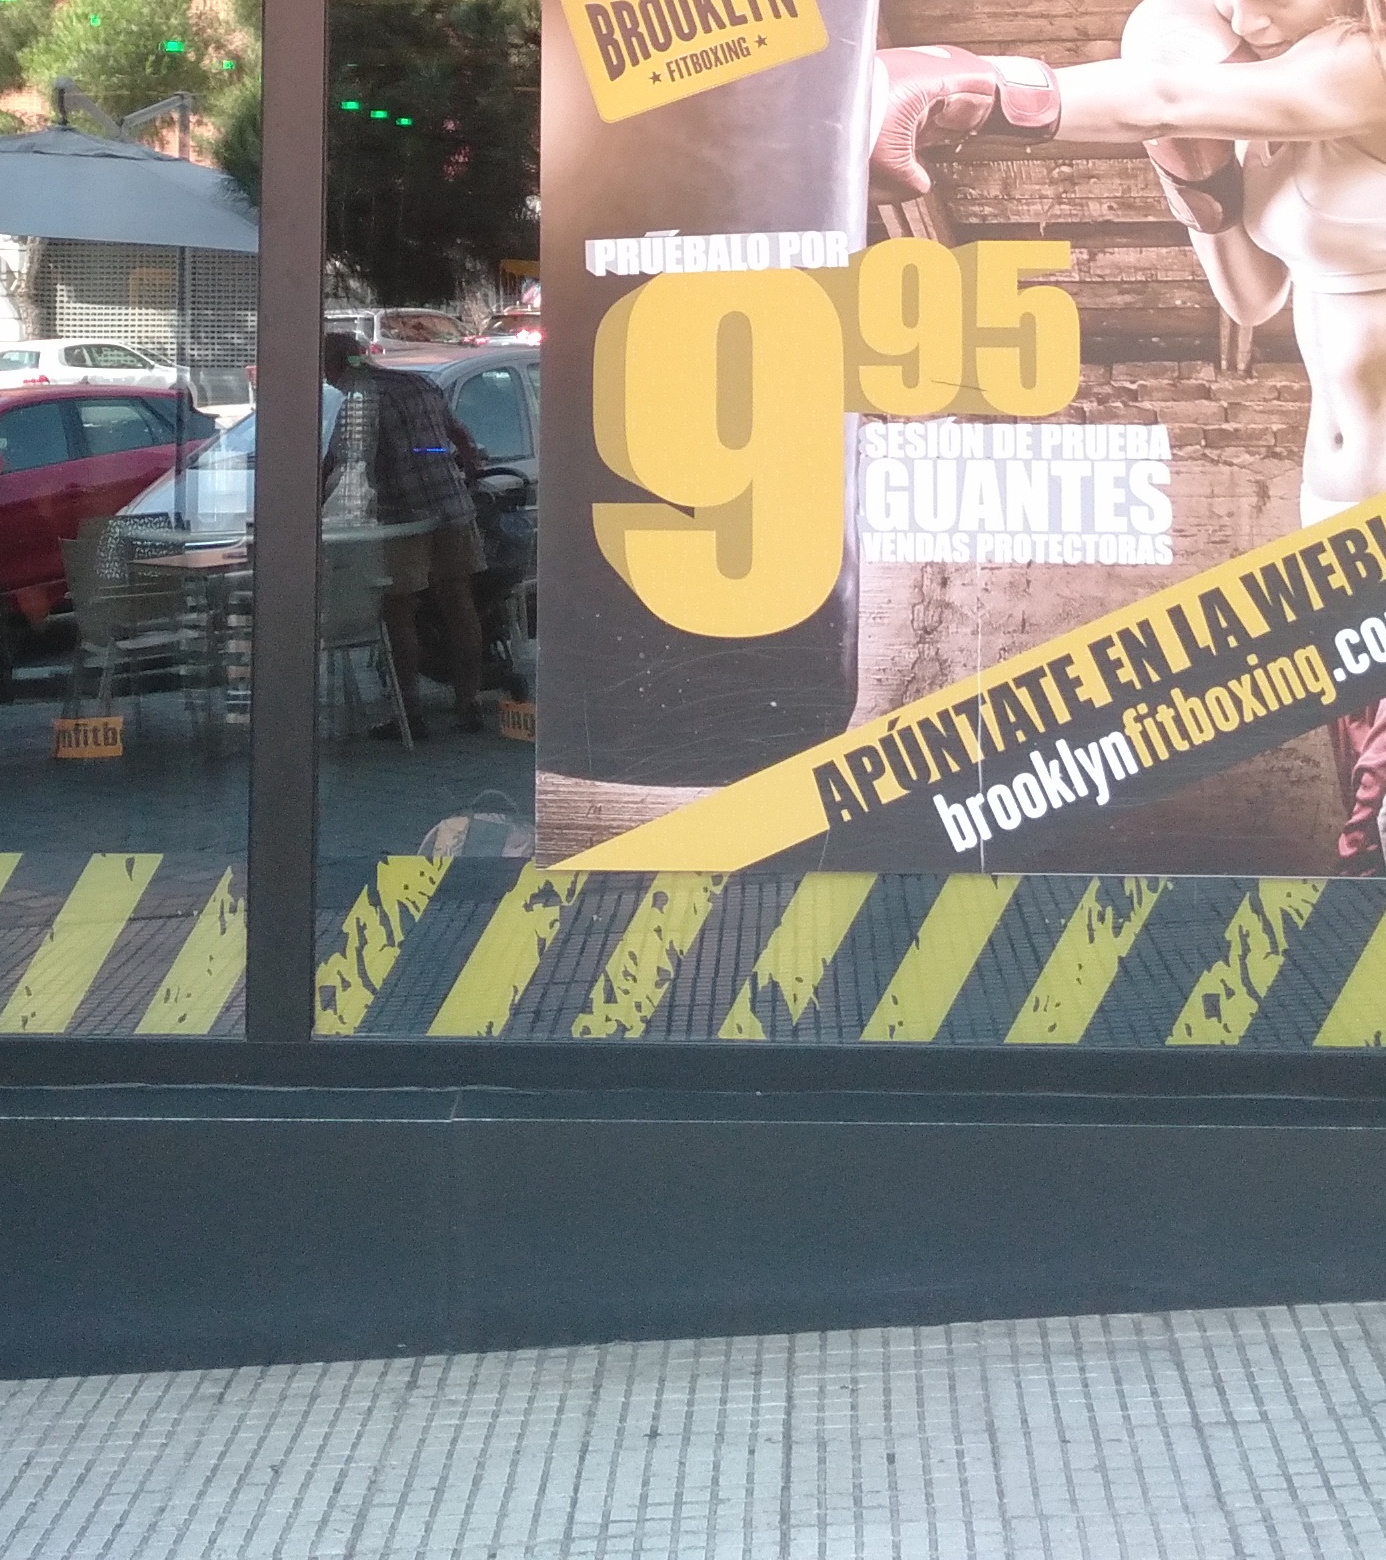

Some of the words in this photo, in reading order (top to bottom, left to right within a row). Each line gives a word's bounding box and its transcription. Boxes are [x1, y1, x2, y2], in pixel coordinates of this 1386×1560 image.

[666, 36, 752, 83] FITBOXING
[590, 229, 770, 277] PRUÉBALO
[779, 230, 850, 269] POR
[605, 266, 845, 638] 9
[857, 236, 1081, 417] 95
[862, 416, 984, 459] SESIÓN
[992, 423, 1033, 459] DE
[1041, 423, 1172, 460] PRUEBA
[864, 457, 1173, 534] GUANTES
[861, 531, 970, 563] VENDAS
[976, 533, 1173, 565] PROTECTORAS
[812, 653, 1093, 830] APÚNTATE
[1087, 618, 1164, 692] EN
[1166, 586, 1253, 662] LA
